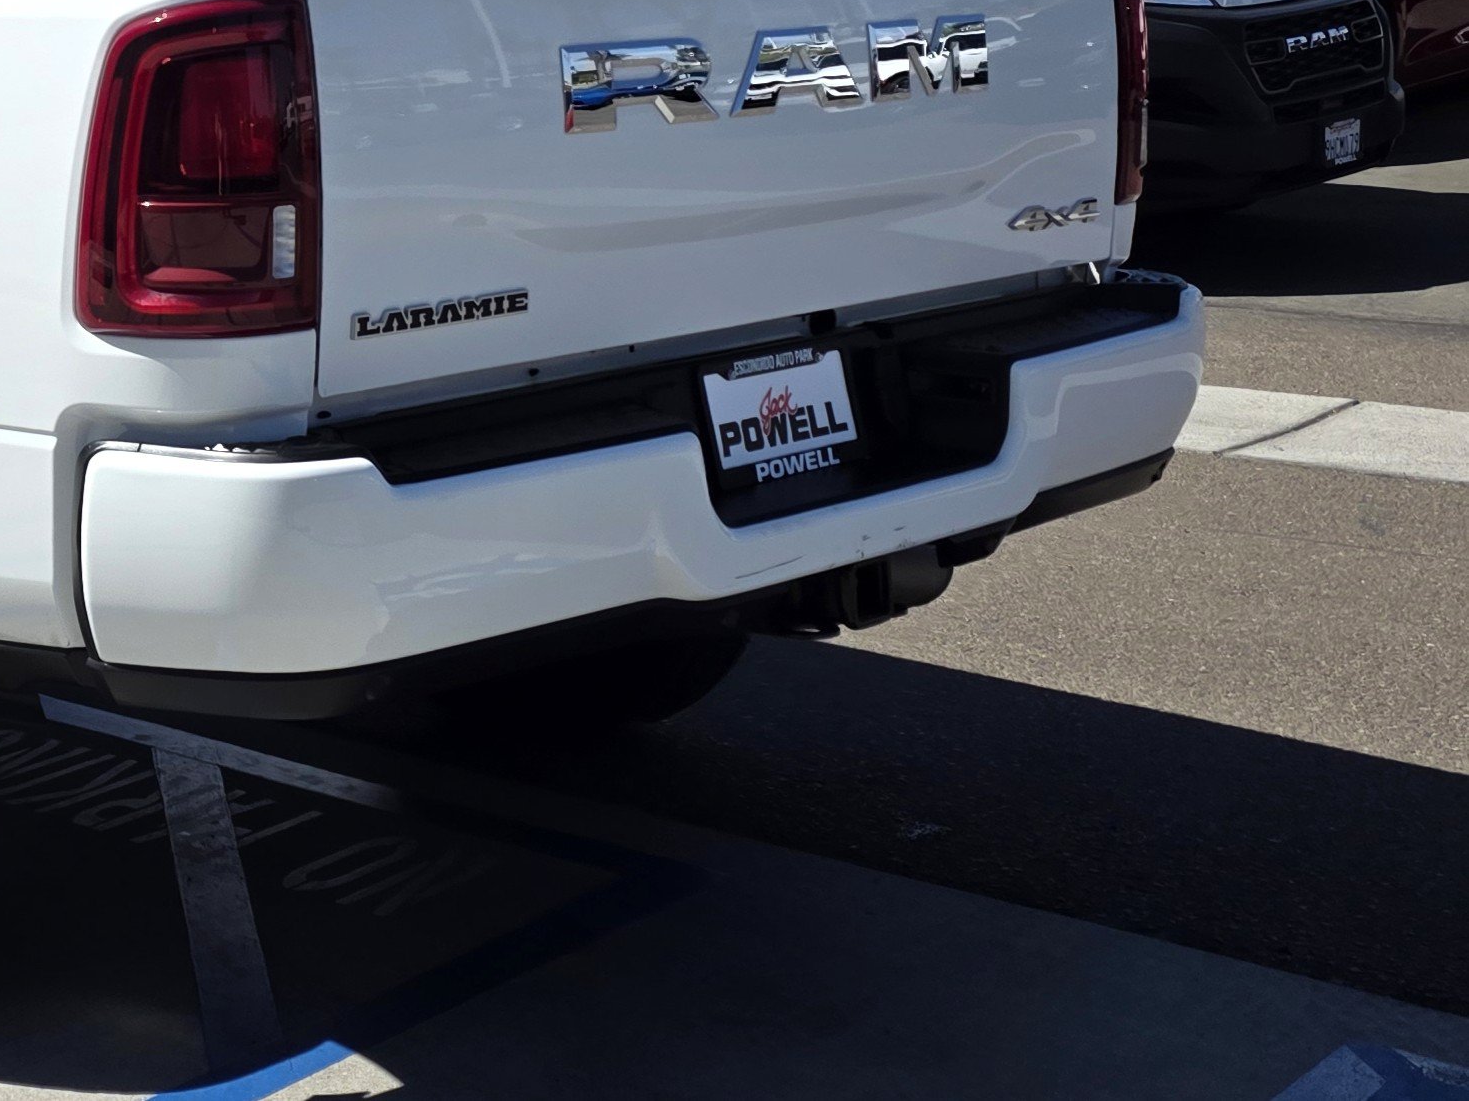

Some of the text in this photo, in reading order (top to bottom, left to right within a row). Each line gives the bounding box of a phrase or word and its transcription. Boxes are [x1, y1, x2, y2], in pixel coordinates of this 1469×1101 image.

[1286, 25, 1349, 54] RAM
[560, 13, 989, 134] RAM
[351, 288, 529, 340] LARAMIE
[775, 351, 794, 367] AUTO
[795, 348, 814, 364] PARK
[718, 401, 849, 458] POWELL
[755, 447, 841, 483] POWELL
